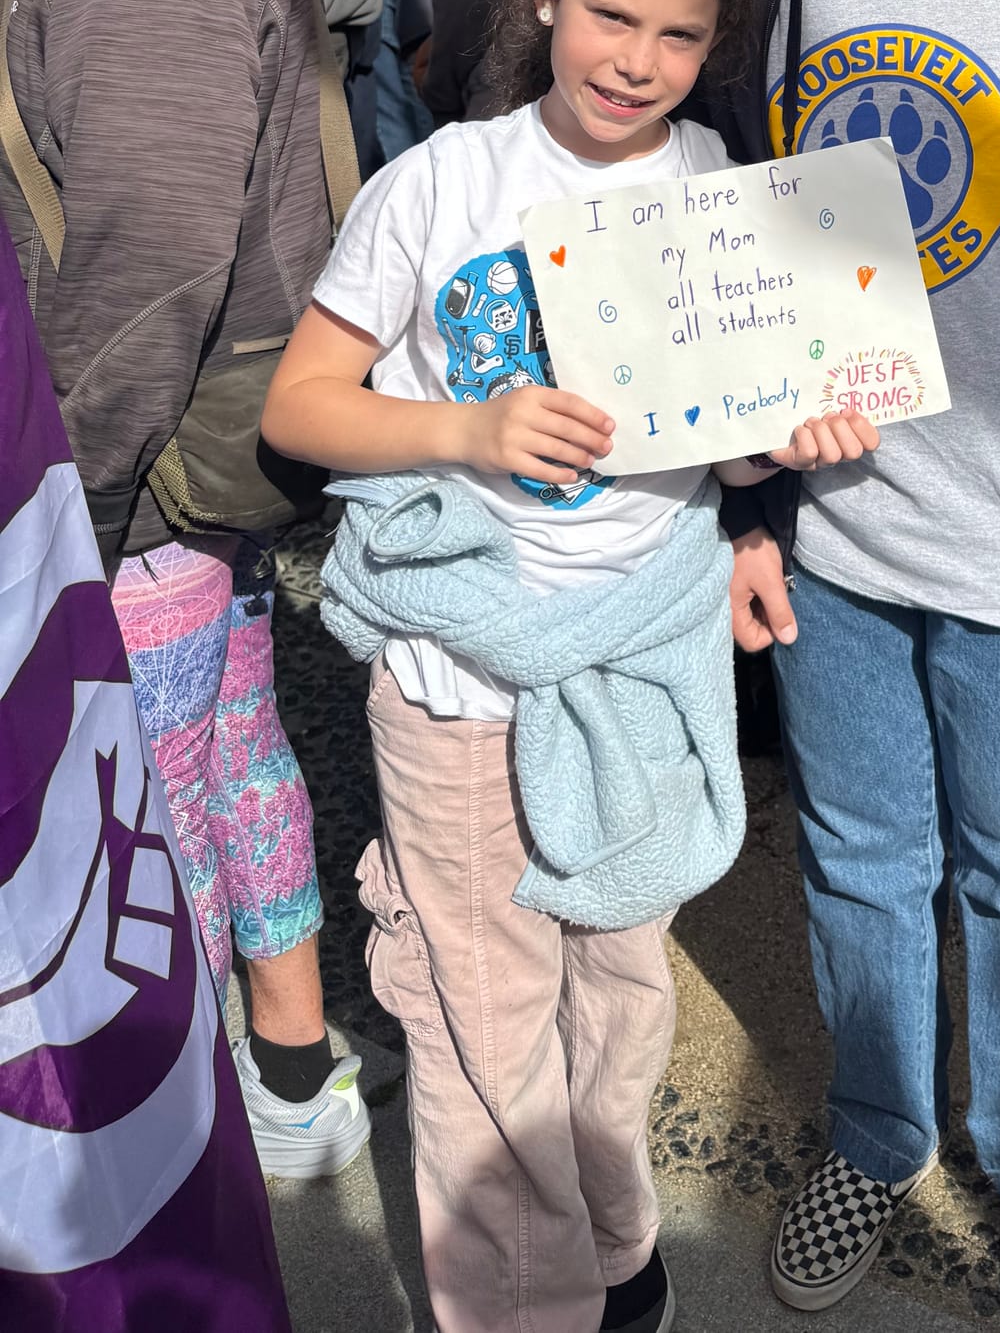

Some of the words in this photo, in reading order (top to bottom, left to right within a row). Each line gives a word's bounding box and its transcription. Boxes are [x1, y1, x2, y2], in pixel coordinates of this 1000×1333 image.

[584, 200, 607, 233] I
[632, 202, 664, 226] am
[684, 181, 739, 215] here
[768, 166, 802, 200] for
[661, 247, 686, 279] my
[709, 227, 755, 253] Mom
[917, 219, 983, 275] ES
[668, 279, 695, 310] all
[712, 267, 794, 302] teachers
[672, 312, 701, 345] all
[718, 301, 797, 335] students
[847, 359, 904, 387] UESF
[645, 411, 660, 436] I
[723, 377, 800, 420] Peabody
[837, 385, 912, 414] STRONG
